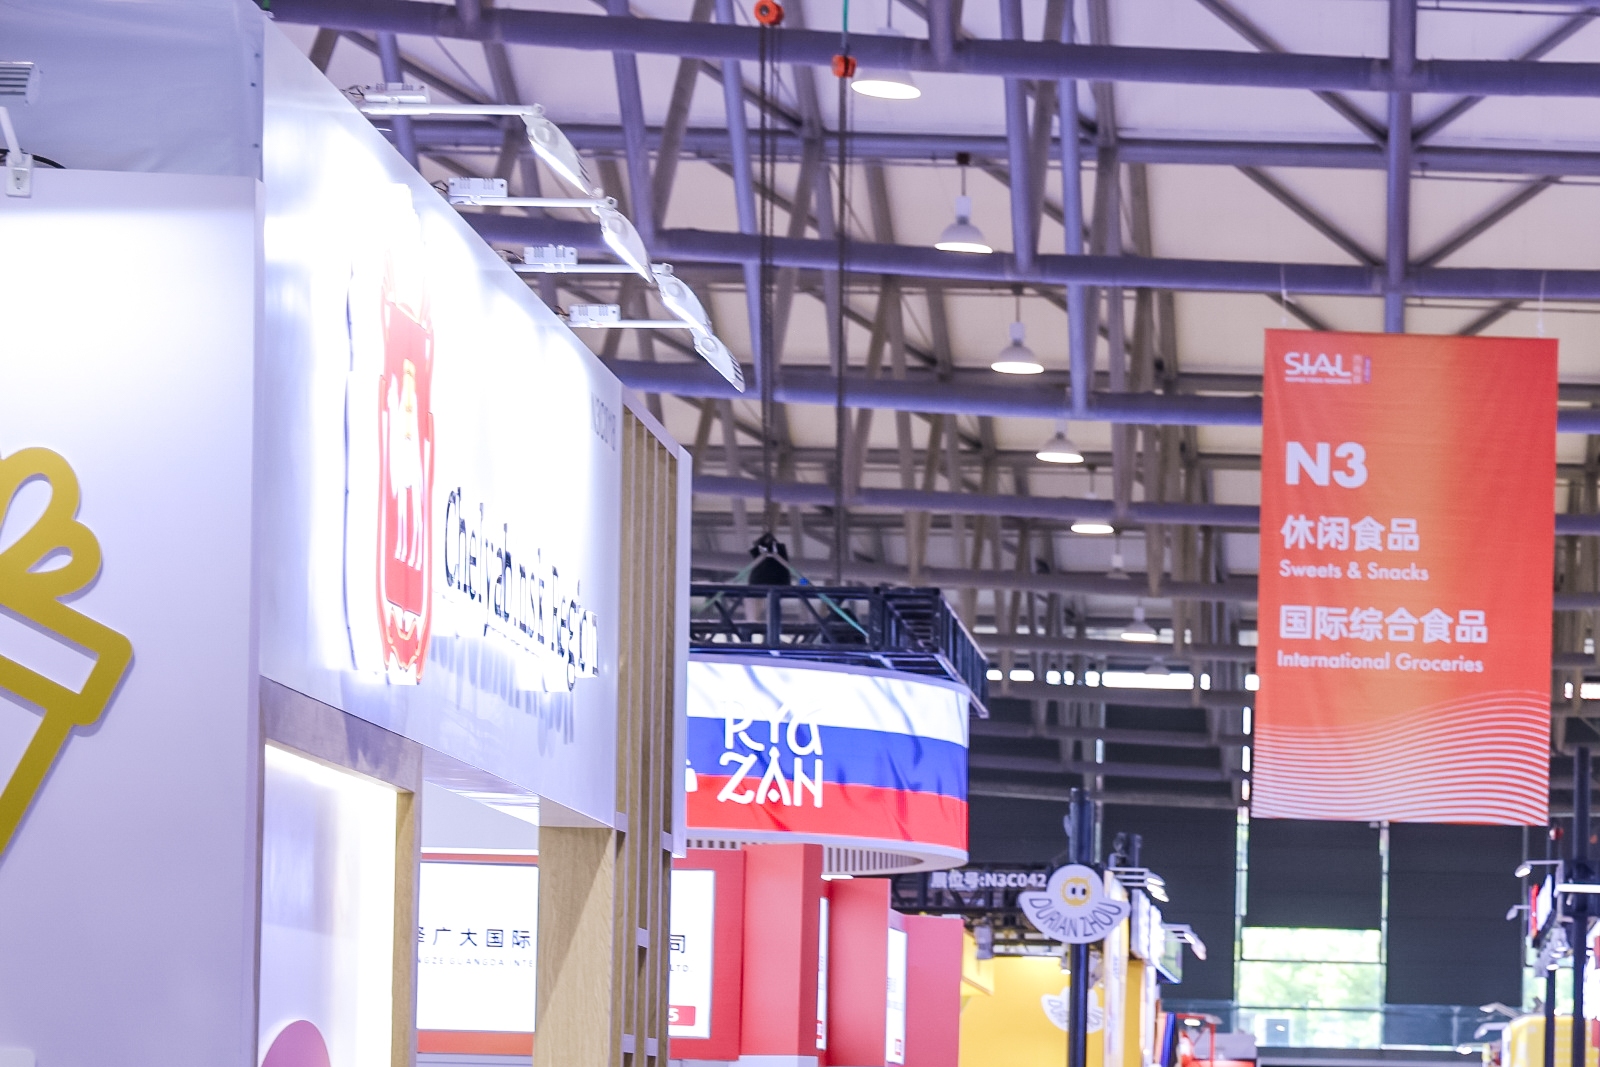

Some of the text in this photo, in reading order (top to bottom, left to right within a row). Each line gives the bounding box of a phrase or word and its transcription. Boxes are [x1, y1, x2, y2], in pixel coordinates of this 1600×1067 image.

[1284, 352, 1351, 377] SIAL
[1285, 441, 1368, 488] N3
[1281, 515, 1420, 553] 休闲食品
[445, 486, 545, 646] Chelyabnsk
[1279, 558, 1430, 582] Sweets & Snacks
[1279, 605, 1488, 645] 国际综合食品
[1277, 650, 1484, 673] International Groceries
[717, 746, 823, 808] ZAN
[1029, 898, 1122, 938] DURIAN ZHOU
